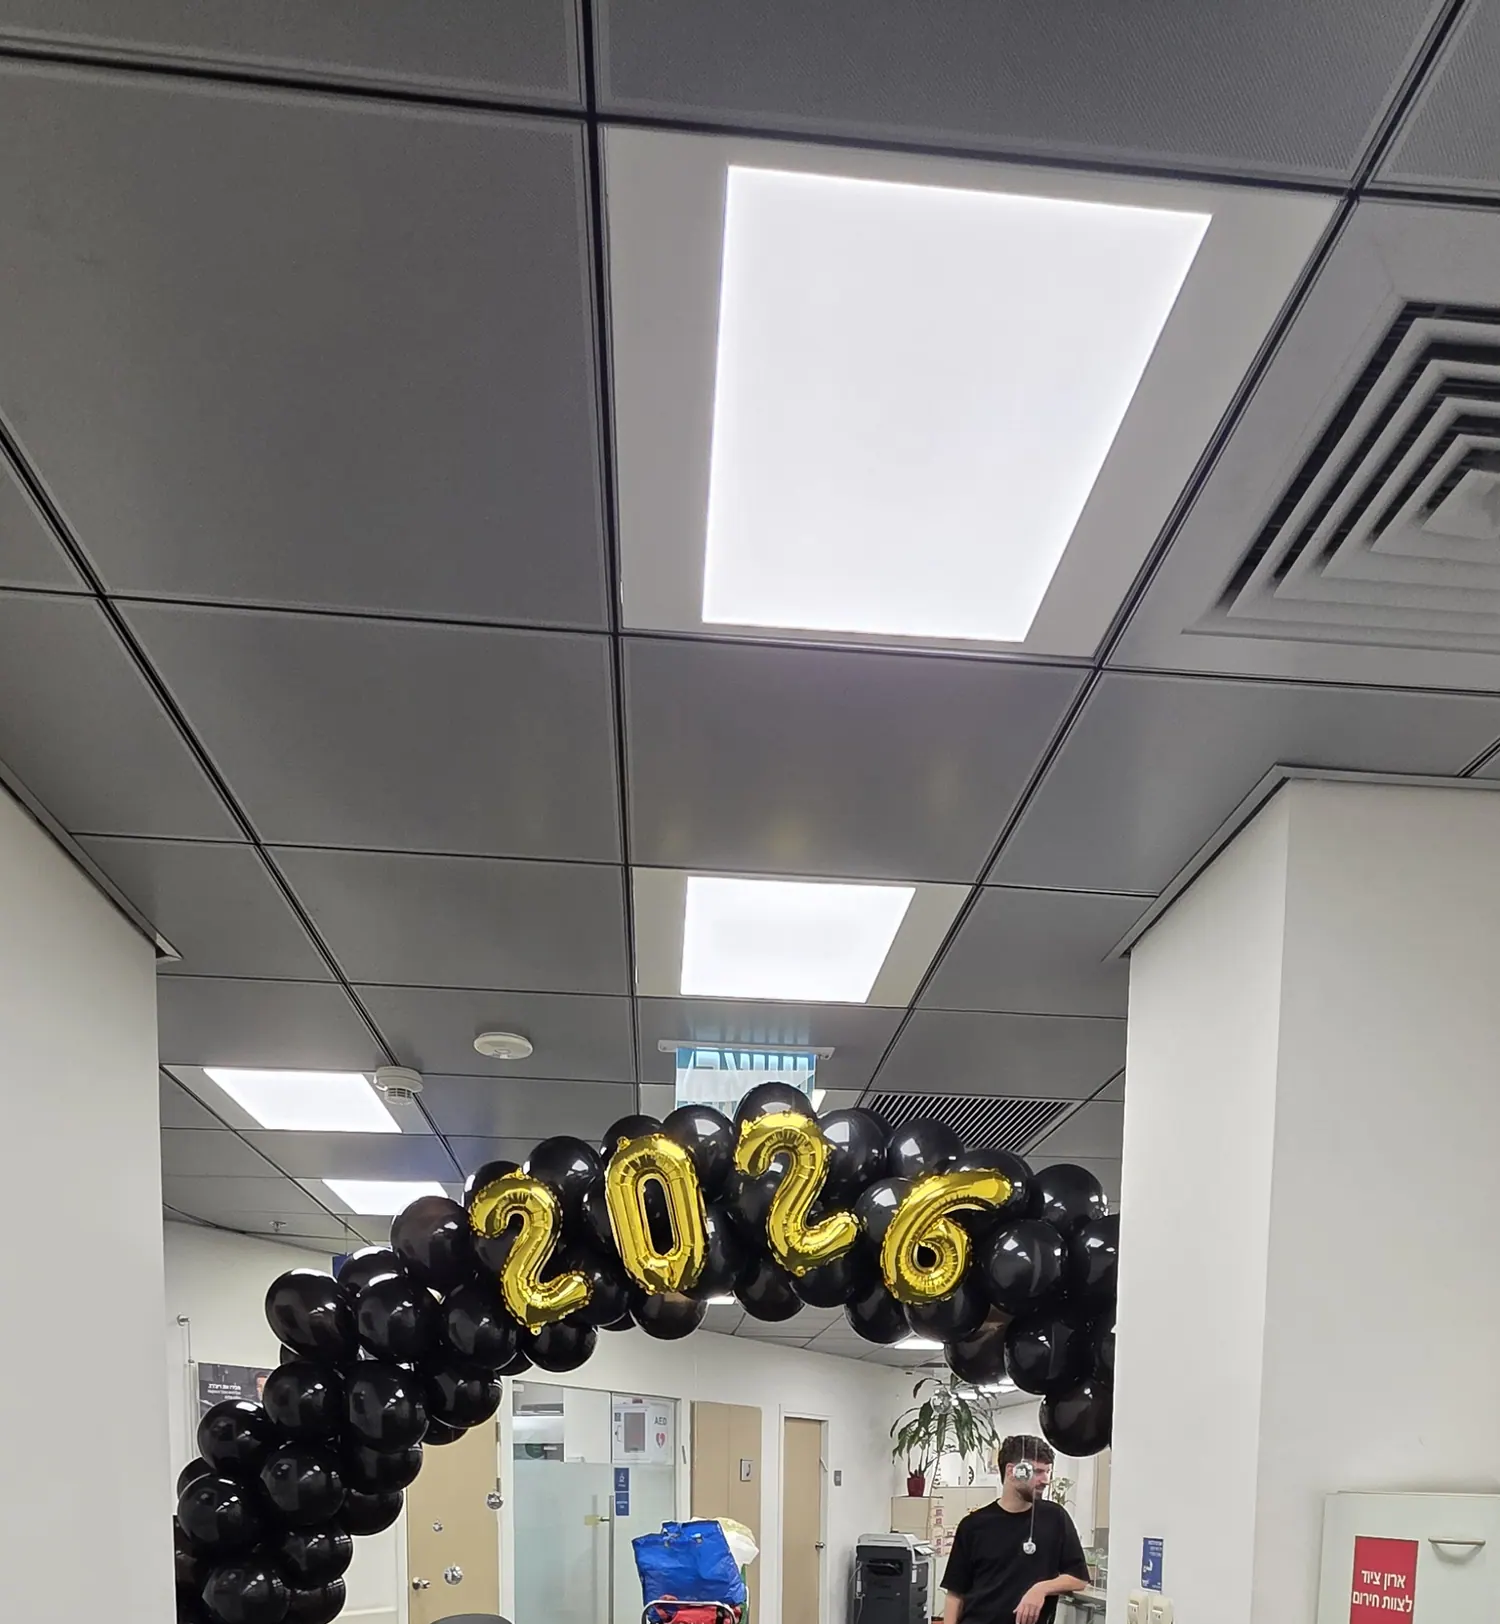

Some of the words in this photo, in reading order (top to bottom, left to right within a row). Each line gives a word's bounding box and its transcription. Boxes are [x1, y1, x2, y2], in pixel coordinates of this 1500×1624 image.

[468, 1110, 1012, 1335] 2026
[654, 1417, 667, 1426] AED
[1361, 1570, 1381, 1585] ציוד
[1384, 1573, 1406, 1590] ארון
[1352, 1591, 1380, 1608] חירום
[1382, 1595, 1413, 1613] לצוות
